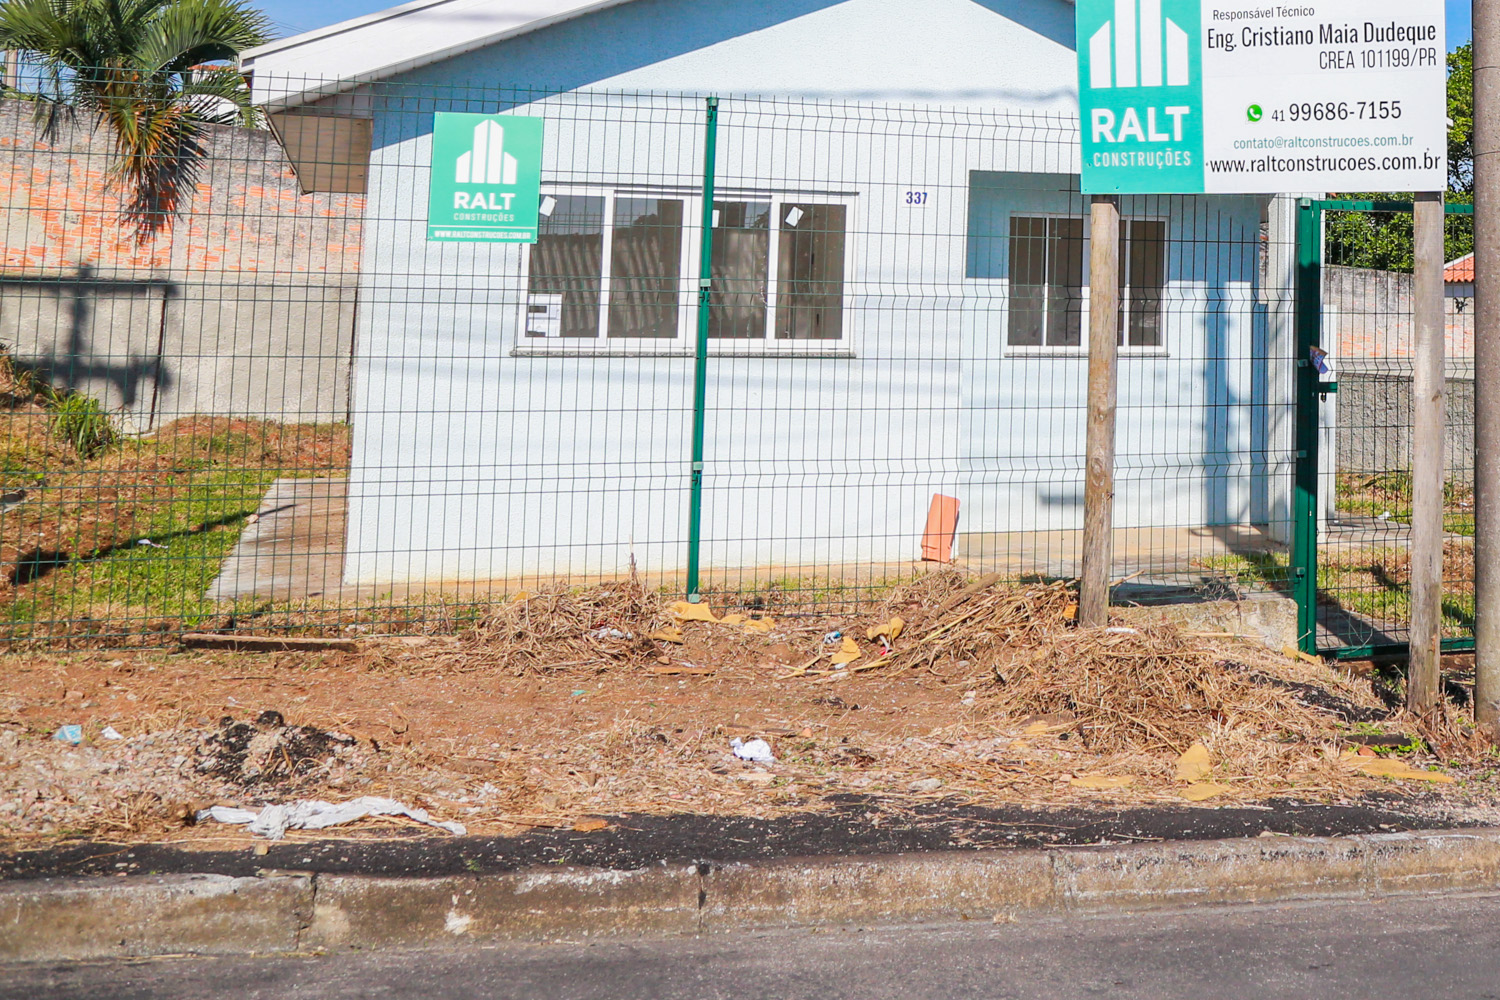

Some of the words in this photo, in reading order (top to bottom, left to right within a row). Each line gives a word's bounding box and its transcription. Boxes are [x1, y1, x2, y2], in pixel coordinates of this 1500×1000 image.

[1213, 7, 1274, 22] Responsável
[1276, 5, 1315, 18] Técnico
[1207, 28, 1237, 52] Eng.
[1241, 26, 1314, 47] Cristiano
[1319, 23, 1358, 45] Maia
[1363, 21, 1436, 46] Dudeque
[1319, 50, 1355, 70] CREA
[1360, 47, 1437, 69] 101199/PR
[1271, 109, 1286, 122] 41
[1289, 100, 1402, 122] 99686-7155
[1091, 106, 1190, 143] RALT
[1233, 133, 1414, 150] contato@raltconstrucoes.com.br
[1093, 147, 1192, 170] CONSTRUÇÕES
[1210, 151, 1441, 173] www.raltconstrucoes.com.br
[454, 191, 516, 210] RALT
[905, 191, 928, 205] 337
[453, 212, 515, 223] CONSTRUÇÕES
